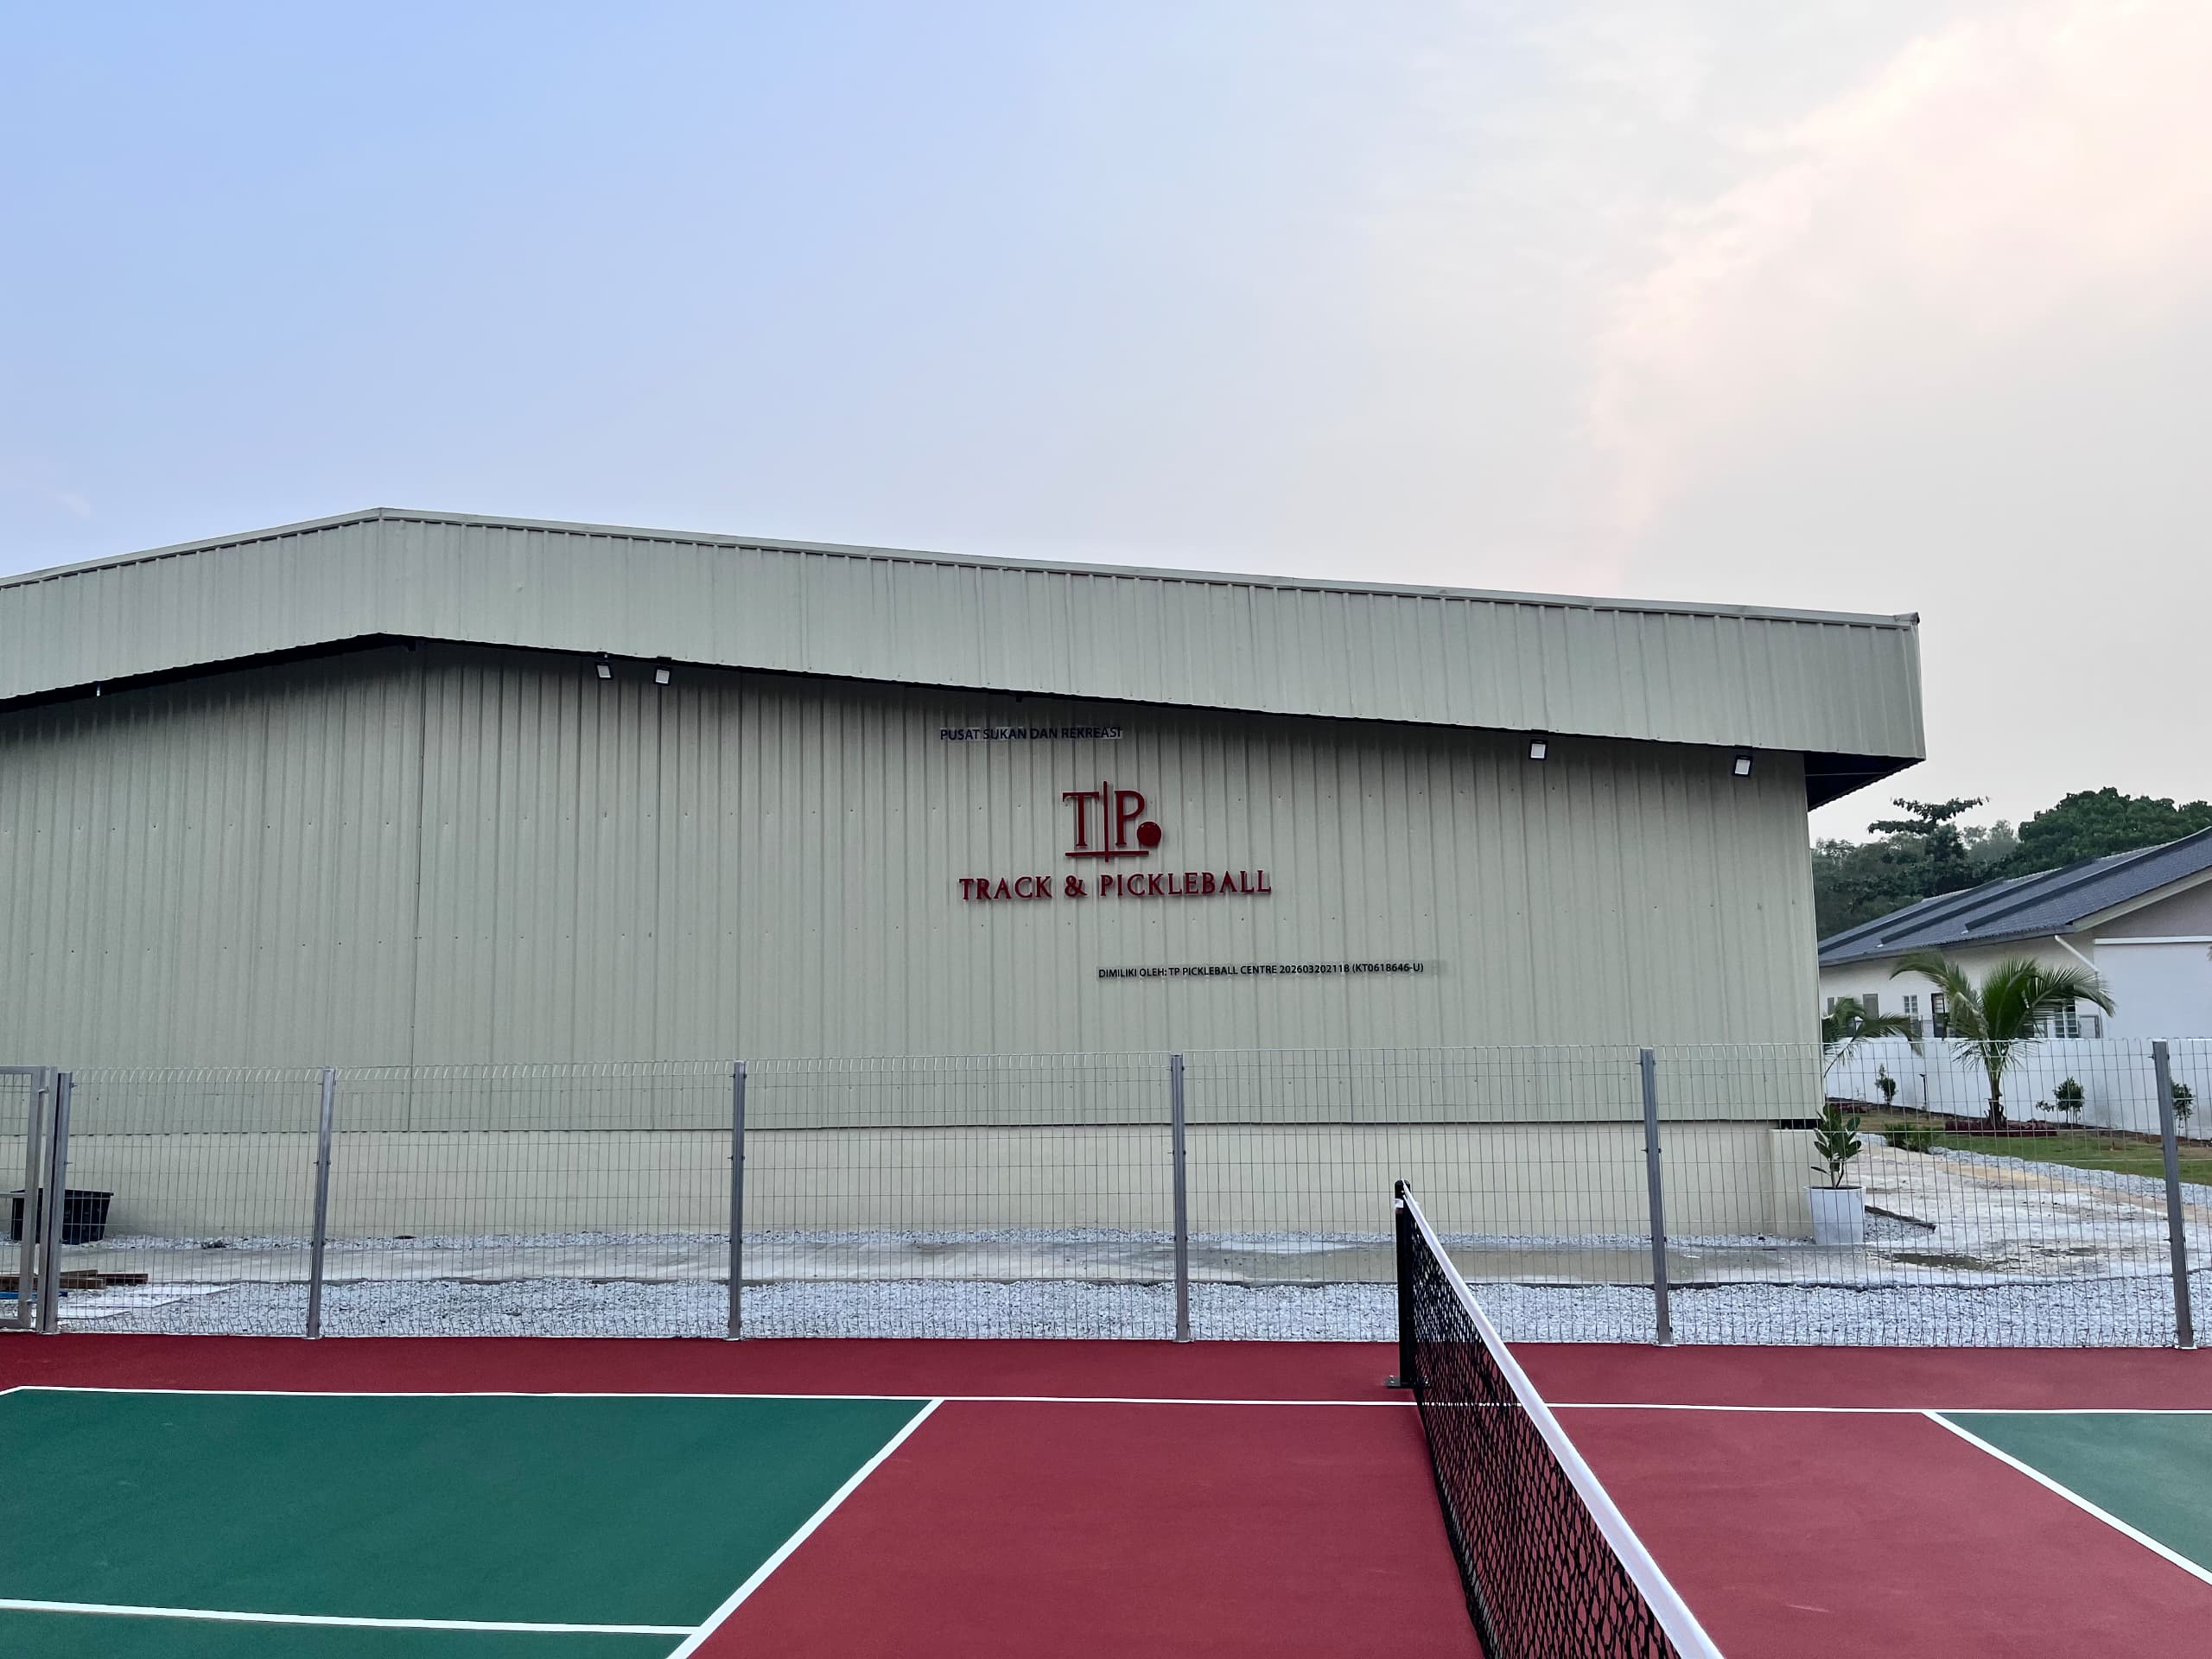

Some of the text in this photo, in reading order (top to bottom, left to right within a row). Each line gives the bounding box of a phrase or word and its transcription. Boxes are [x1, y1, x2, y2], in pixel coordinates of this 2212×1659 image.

[940, 726, 1122, 741] PUSAT SUKAN DAN REKREASI
[959, 870, 1272, 900] TRACK & PICKLEBALL
[1098, 963, 1424, 978] DIMILIKI OLEH: TP PICKLEBALL CENTRE 202603202118 (KT0618646-U)
